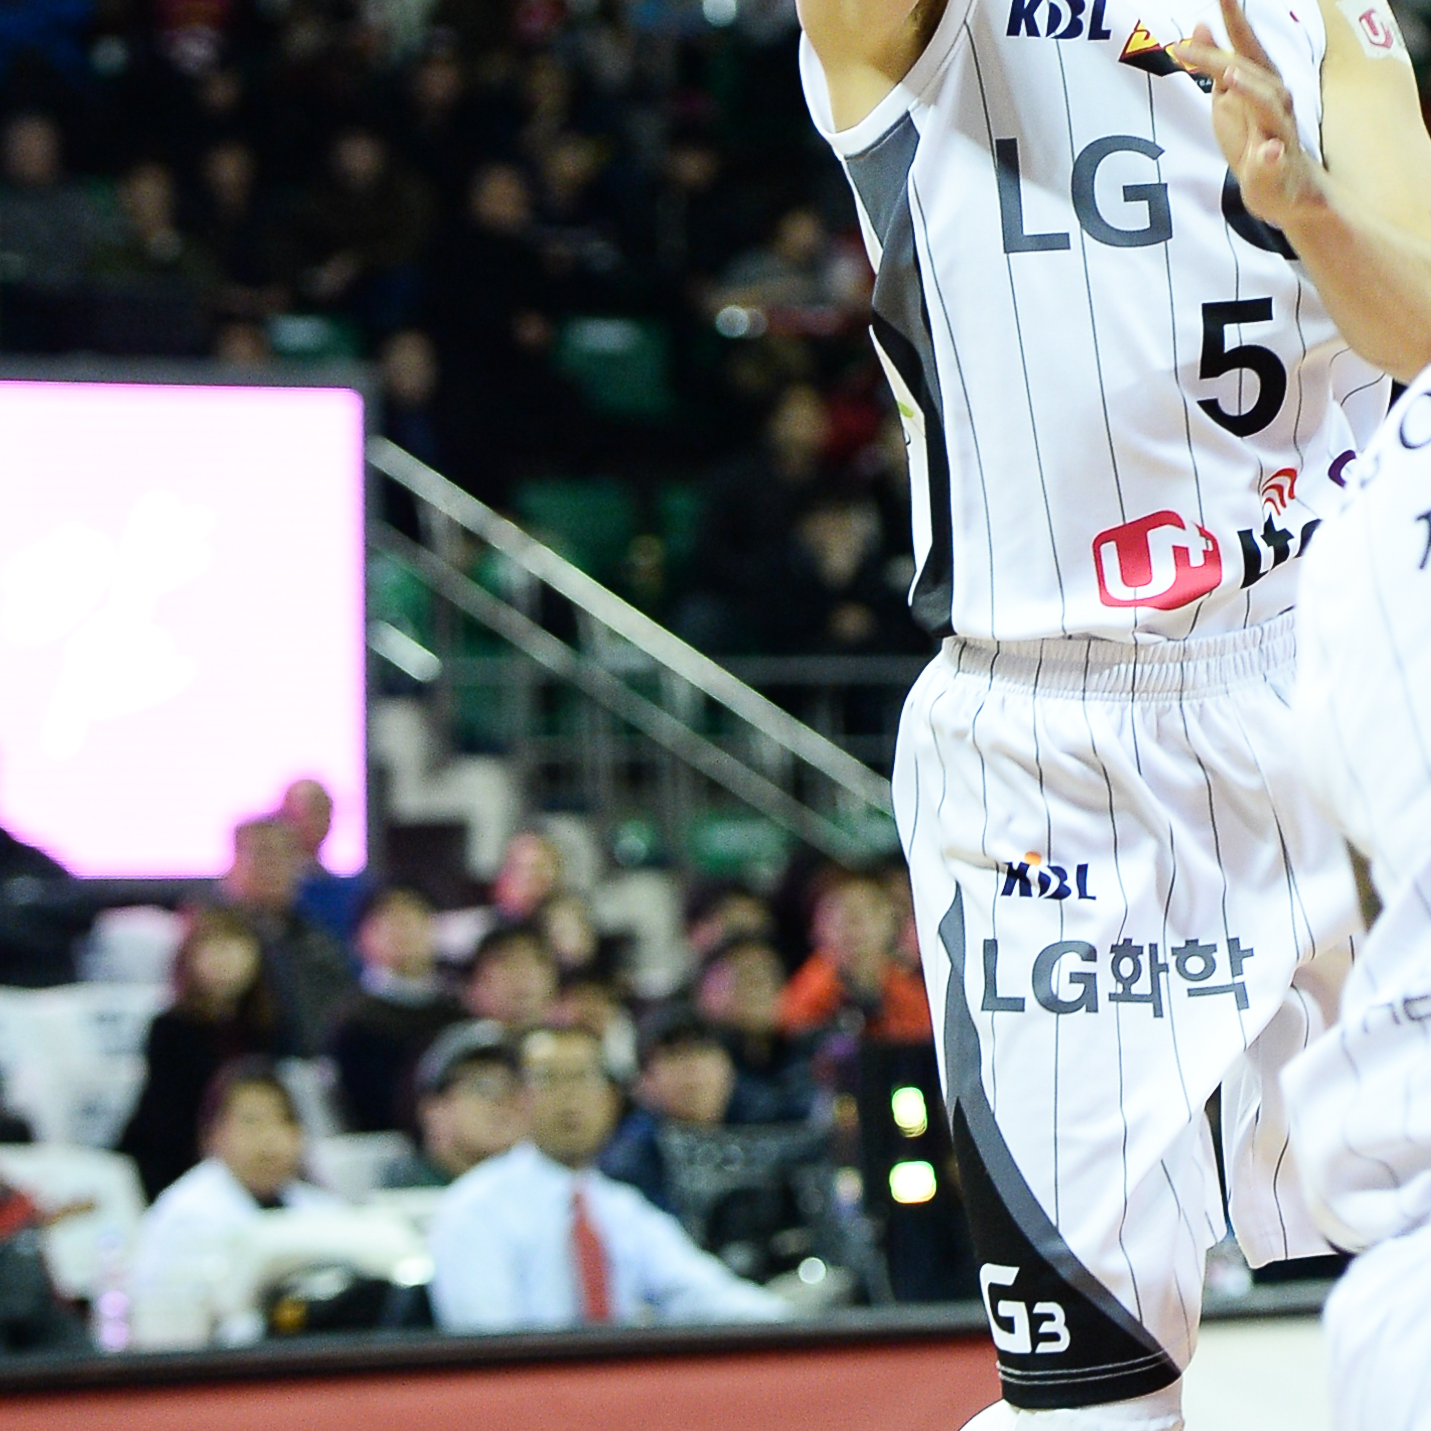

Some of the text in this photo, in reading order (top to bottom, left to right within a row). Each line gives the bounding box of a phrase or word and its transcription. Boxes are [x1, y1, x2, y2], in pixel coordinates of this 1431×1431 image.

[994, 135, 1174, 255] LG
[1196, 297, 1288, 437] 5
[1001, 858, 1098, 902] KBL
[979, 935, 1255, 1020] LG화학
[979, 1263, 1071, 1356] G3
